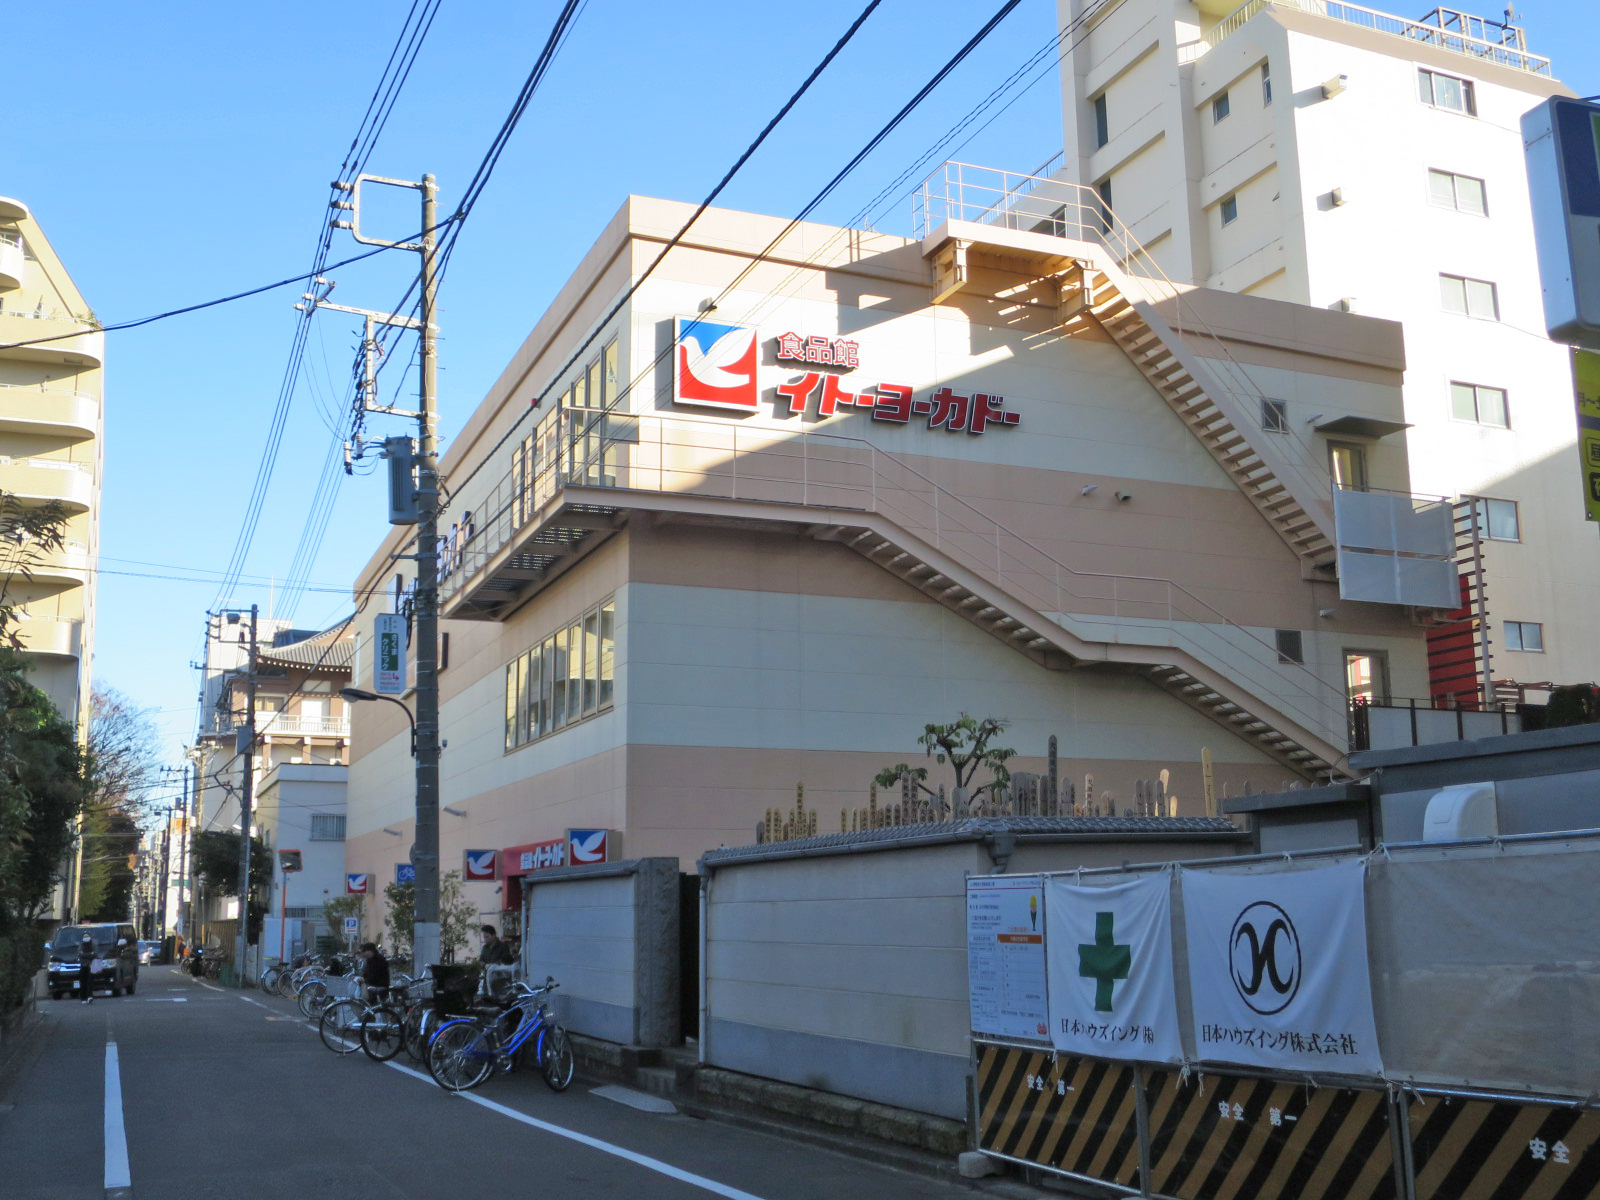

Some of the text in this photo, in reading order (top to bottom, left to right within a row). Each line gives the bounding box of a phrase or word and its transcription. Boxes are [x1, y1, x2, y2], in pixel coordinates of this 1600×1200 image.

[777, 331, 859, 368] 食品館
[777, 372, 1021, 434] イトーヨーカドー
[381, 638, 389, 670] クリニック
[1202, 1023, 1358, 1056] 日本ハウズイング株式会社
[1027, 1073, 1075, 1096] 安全 第一
[1218, 1101, 1297, 1126] 安全 第一
[1529, 1137, 1569, 1164] 安全
